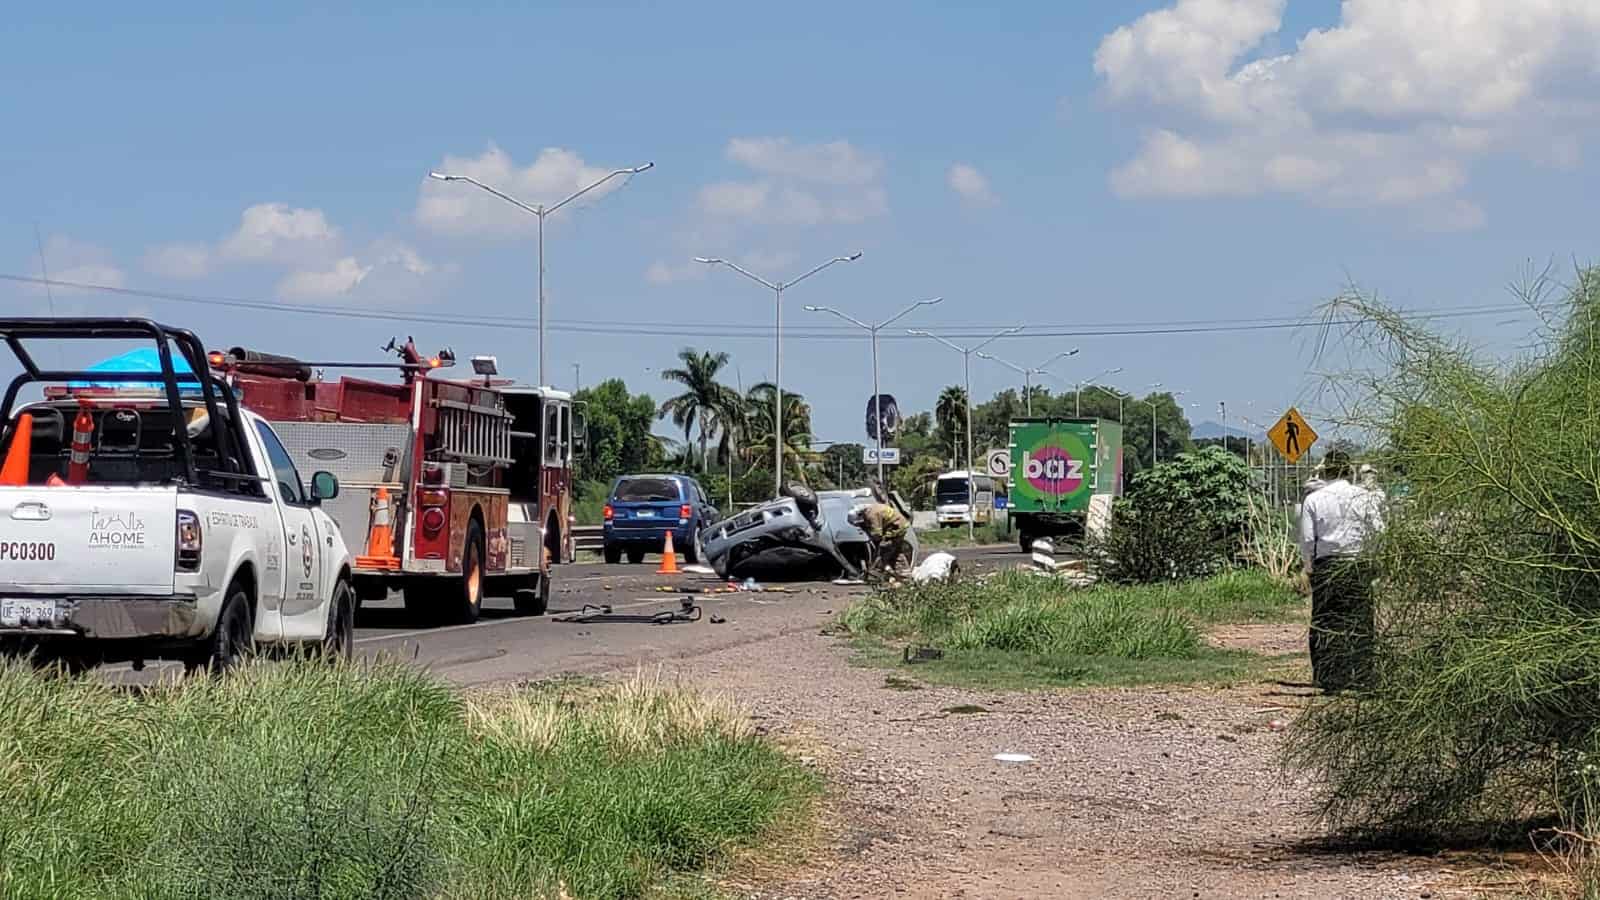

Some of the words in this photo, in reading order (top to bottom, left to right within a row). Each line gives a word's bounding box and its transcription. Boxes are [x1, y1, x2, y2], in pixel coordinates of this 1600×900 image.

[1023, 451, 1084, 479] baz
[89, 532, 145, 544] AHOME
[0, 542, 55, 560] PC0300
